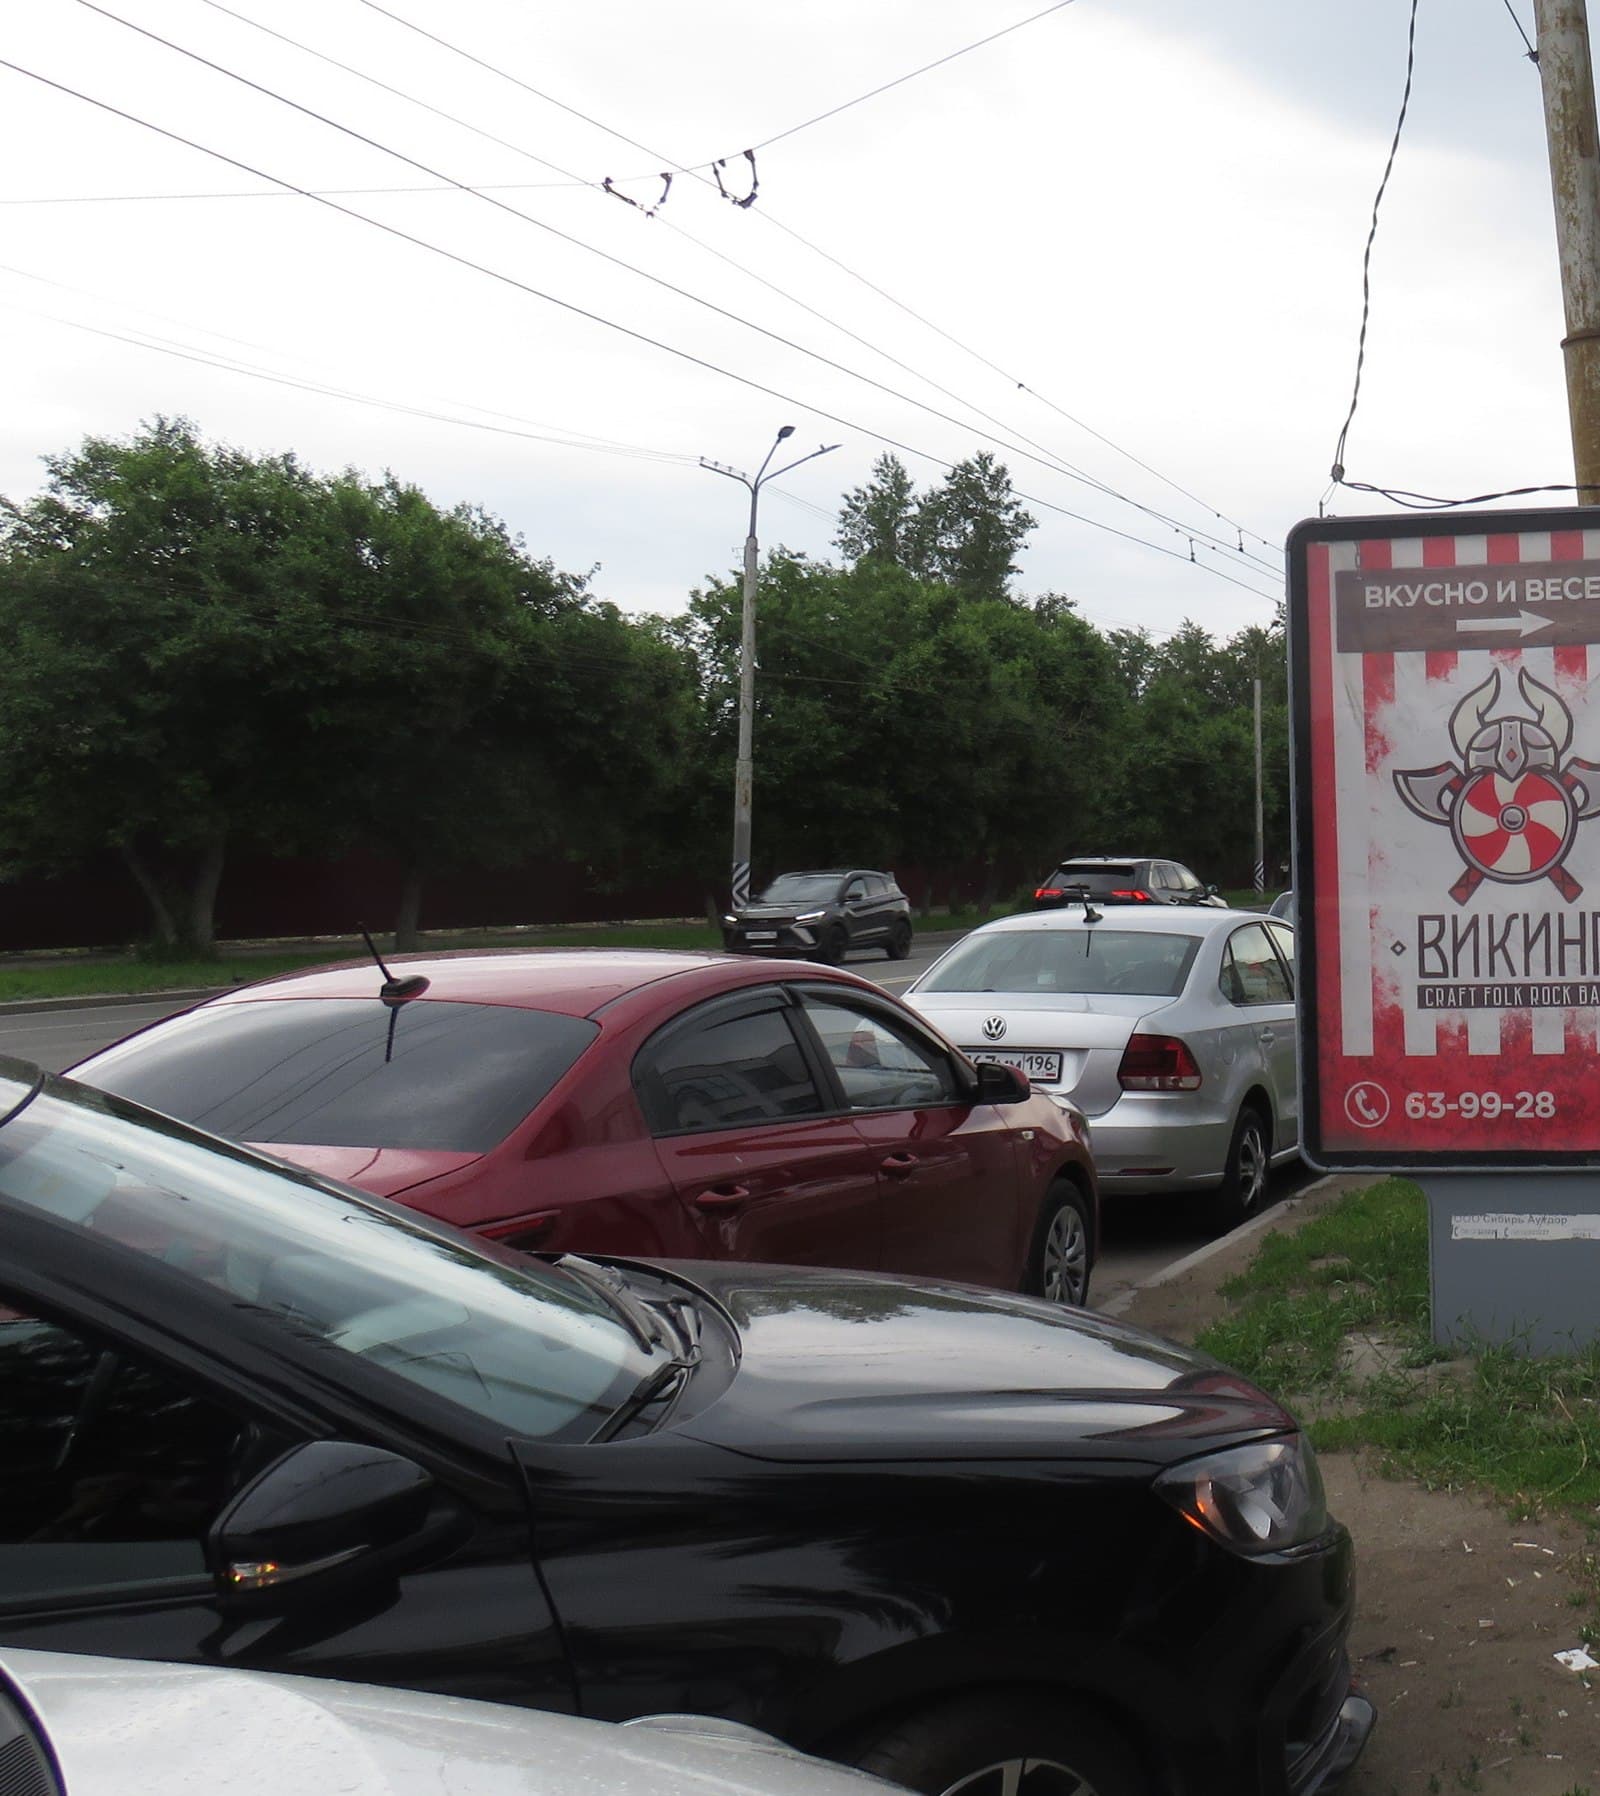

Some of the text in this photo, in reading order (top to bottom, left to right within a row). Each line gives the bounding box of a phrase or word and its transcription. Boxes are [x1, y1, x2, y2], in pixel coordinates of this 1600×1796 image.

[1364, 580, 1489, 609] ВКУСНО
[1497, 581, 1517, 603] И
[1424, 987, 1477, 1008] CRAFT
[1483, 986, 1523, 1006] FOLK
[1530, 985, 1571, 1005] ROCK
[1026, 1055, 1054, 1071] 196
[1404, 1090, 1557, 1120] 63-99-28
